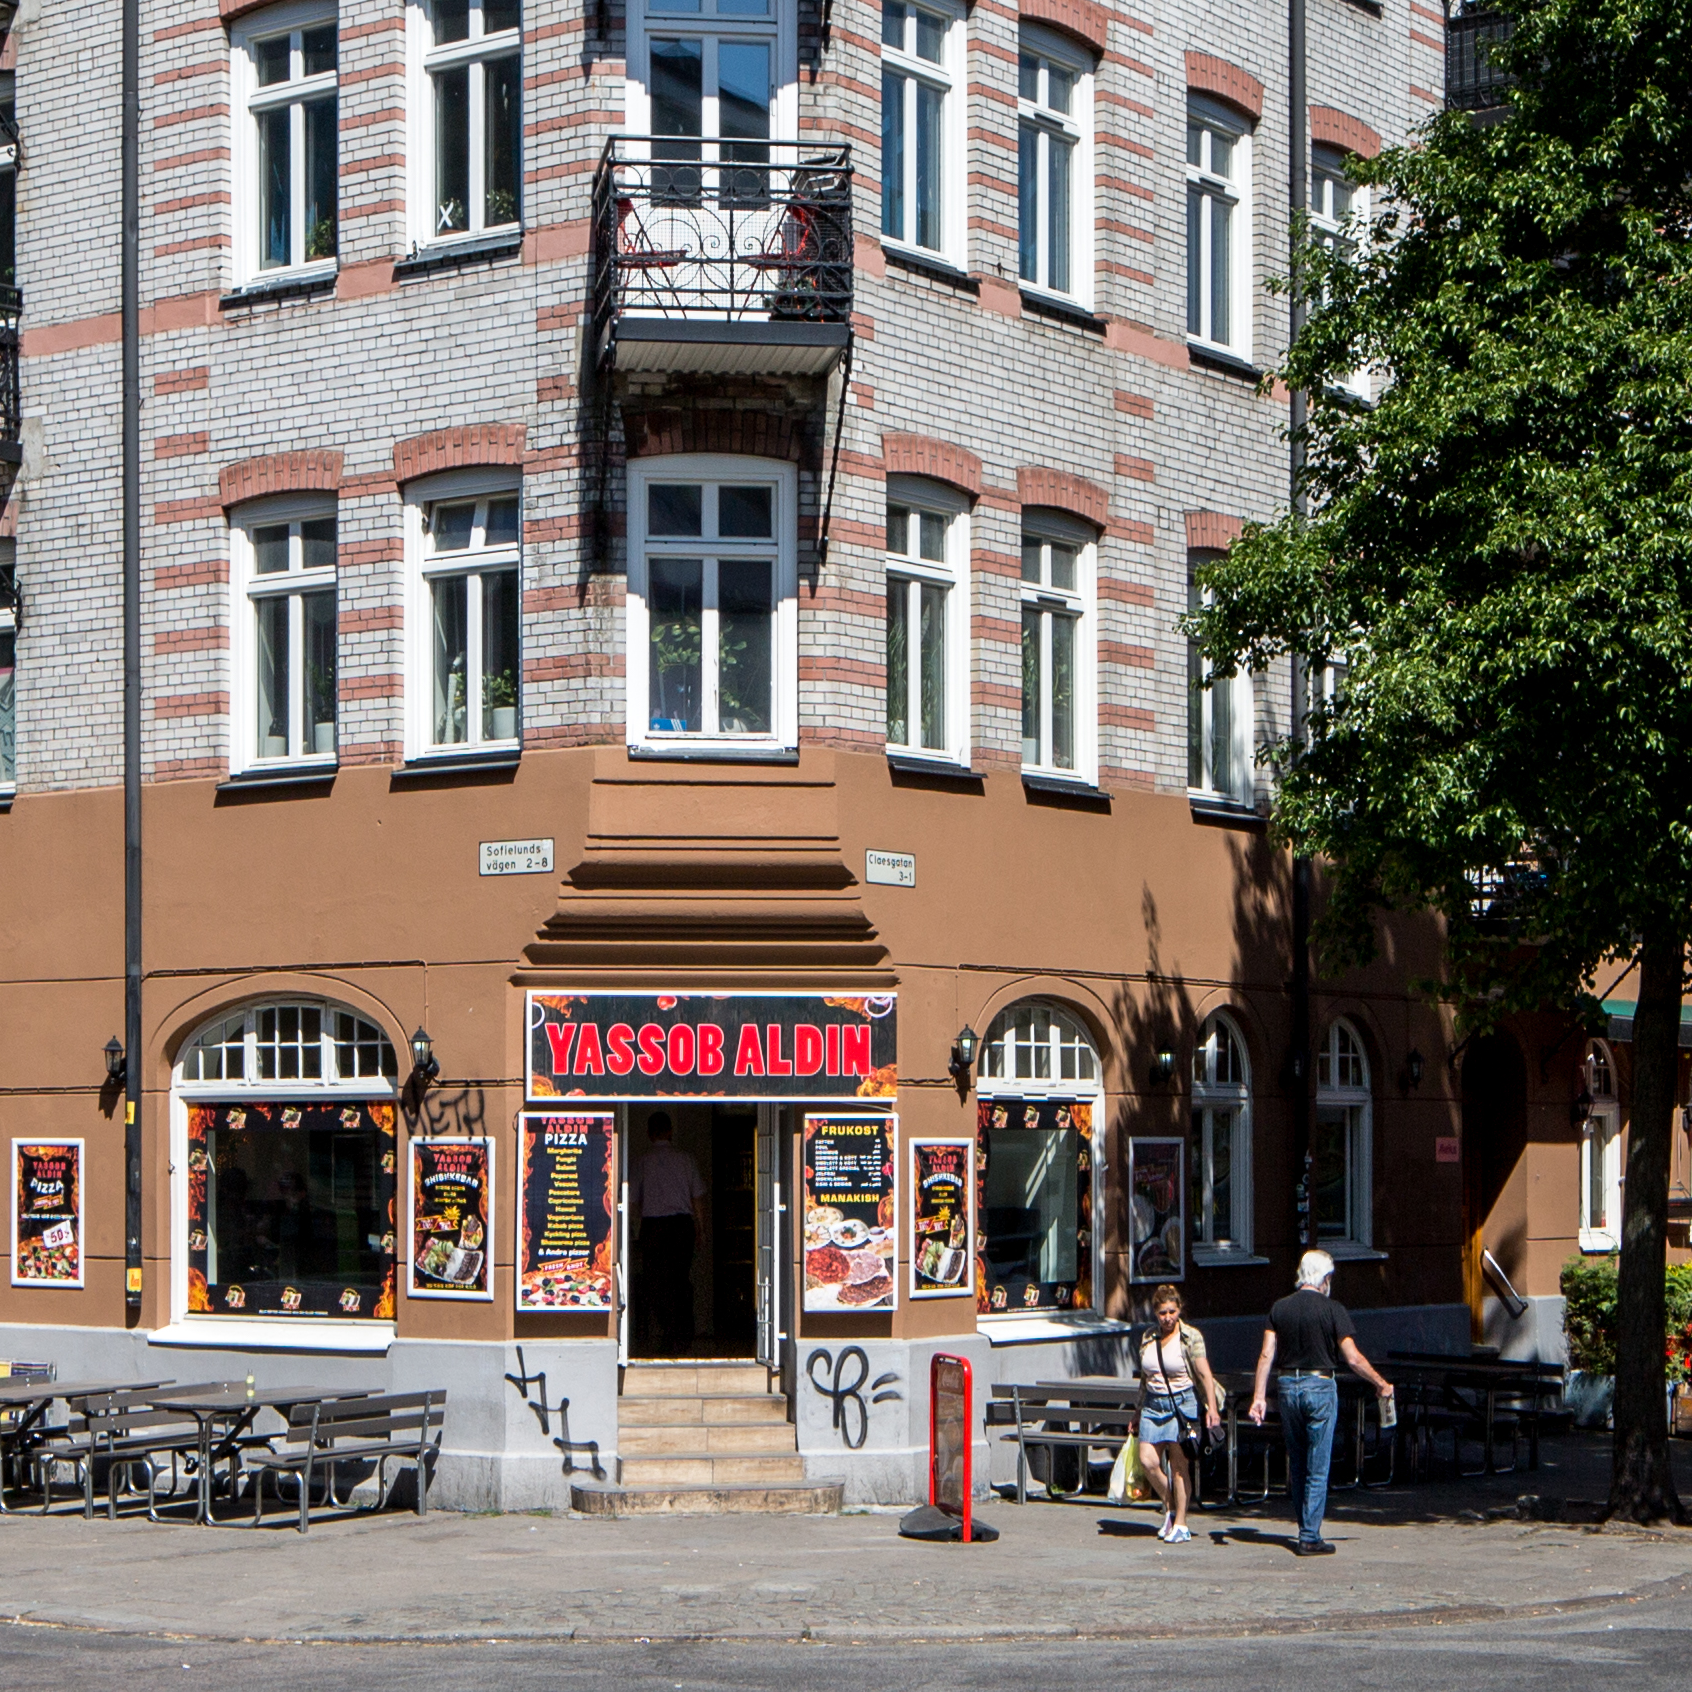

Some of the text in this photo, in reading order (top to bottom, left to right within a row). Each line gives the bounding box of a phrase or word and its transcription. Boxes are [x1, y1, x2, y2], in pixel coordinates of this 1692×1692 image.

[486, 857, 549, 872] vägen 2-8
[868, 854, 913, 869] Claesgatan
[899, 871, 912, 882] 3-1
[544, 1022, 872, 1077] YASSOB ALDIN
[546, 1124, 588, 1134] ALDIN
[821, 1125, 879, 1136] FRUKOST
[544, 1133, 588, 1145] PIZZA
[30, 1177, 65, 1194] PIZZA
[820, 1194, 880, 1203] MANAKISH
